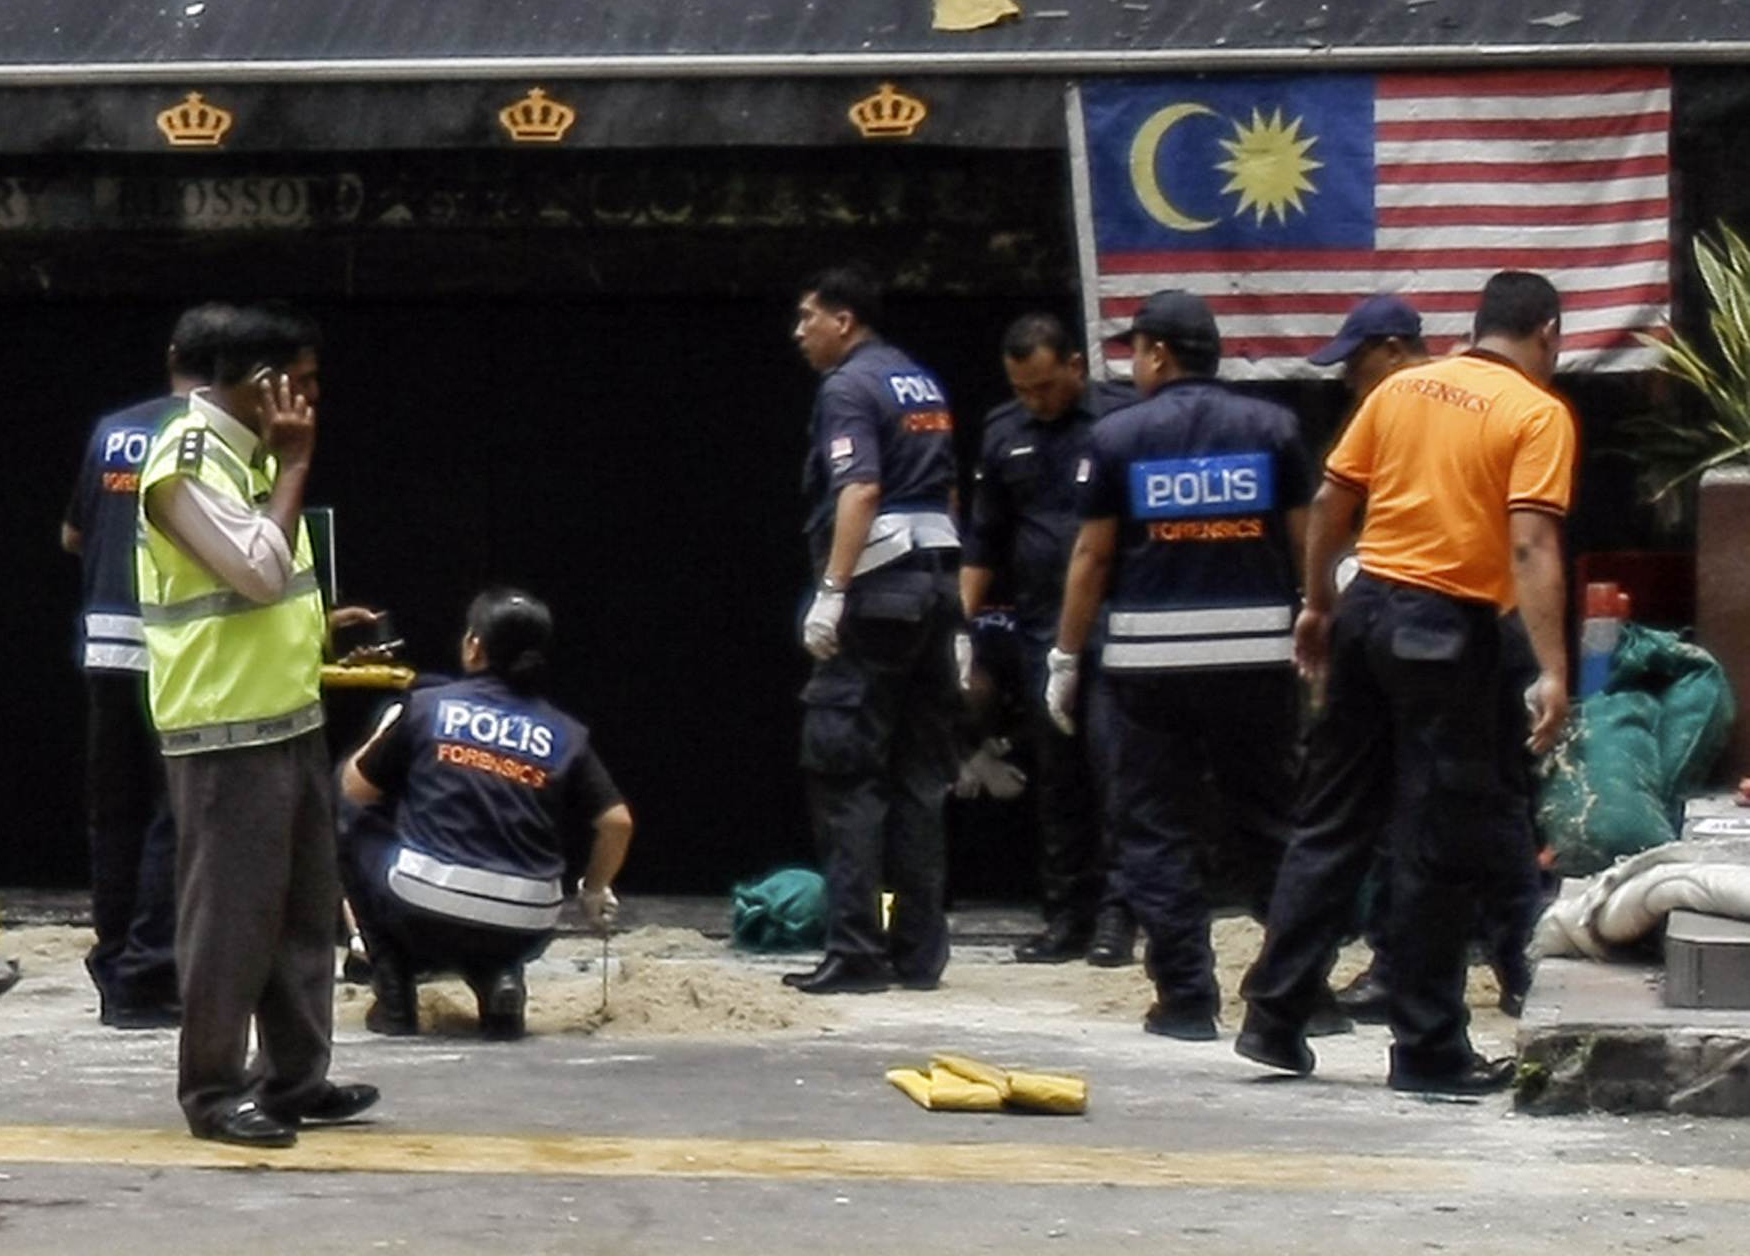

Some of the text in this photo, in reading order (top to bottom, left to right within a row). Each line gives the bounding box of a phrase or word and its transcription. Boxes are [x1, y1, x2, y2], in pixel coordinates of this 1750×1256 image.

[1146, 467, 1259, 508] POLIS
[443, 705, 554, 758] POLIS
[436, 744, 549, 789] FORENSICS
